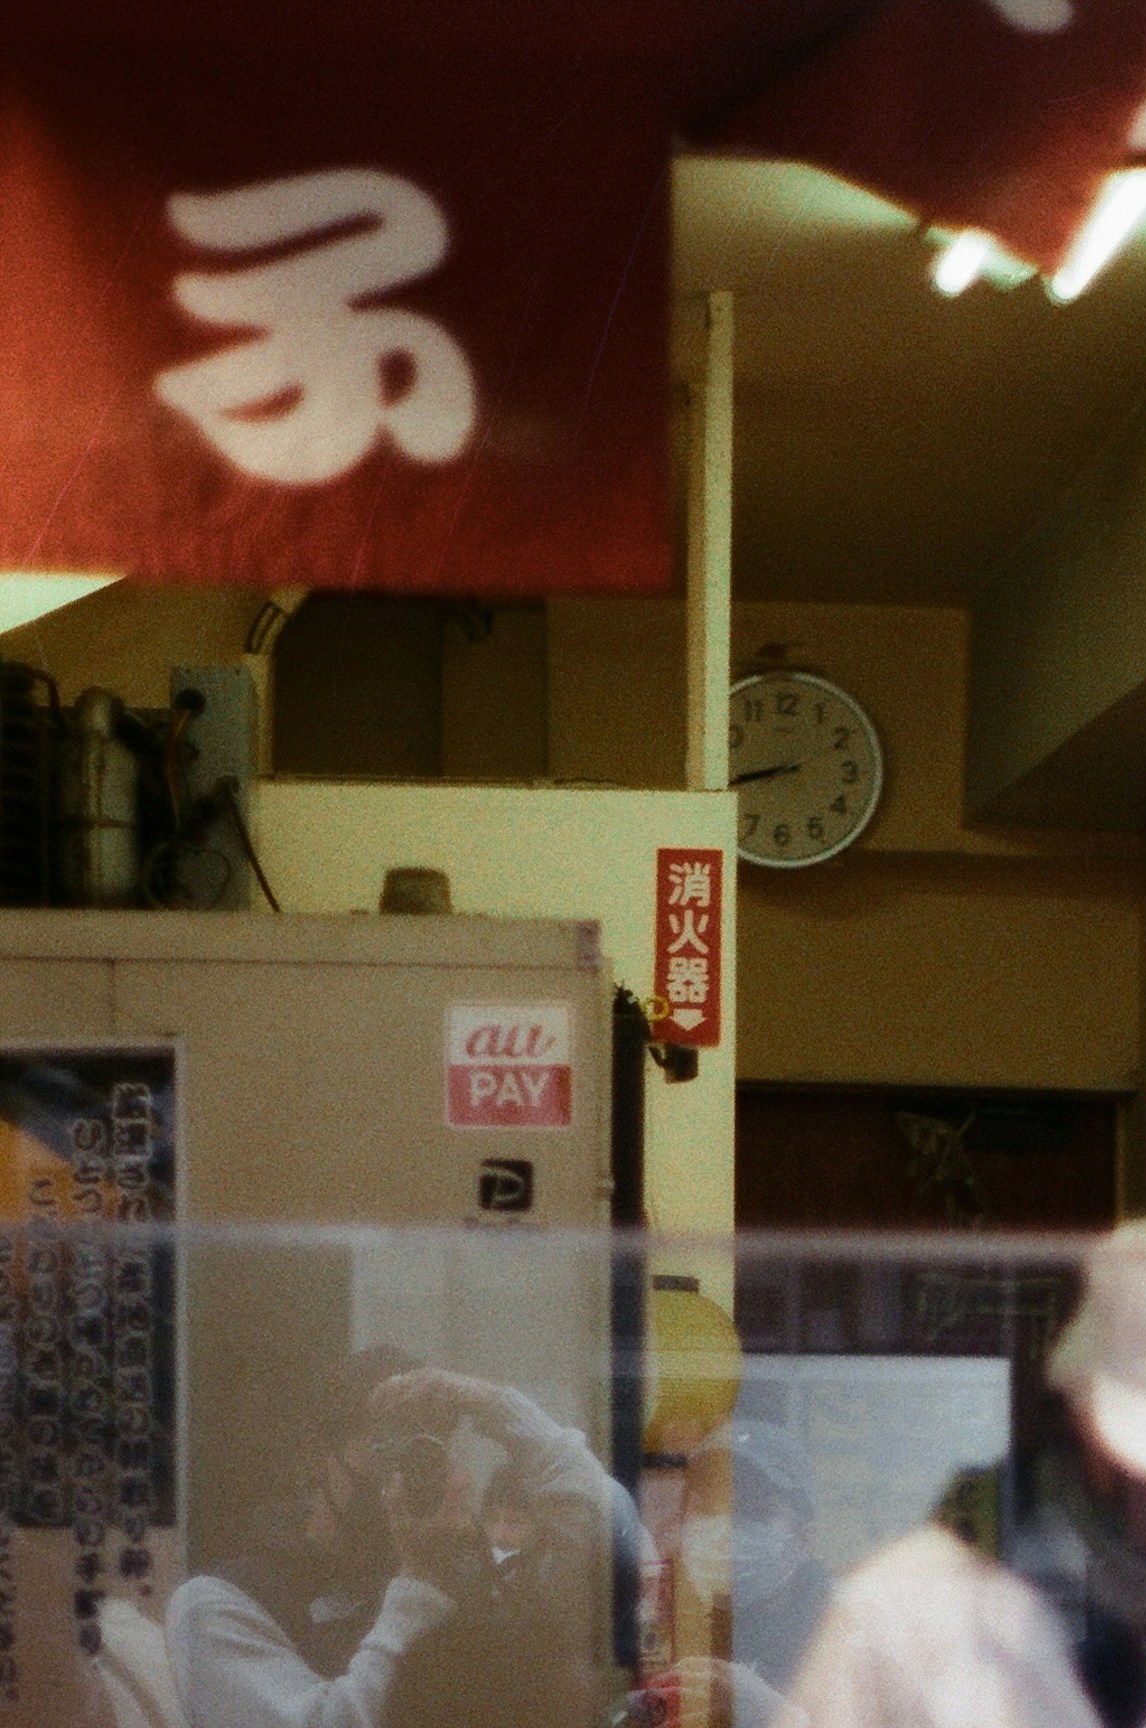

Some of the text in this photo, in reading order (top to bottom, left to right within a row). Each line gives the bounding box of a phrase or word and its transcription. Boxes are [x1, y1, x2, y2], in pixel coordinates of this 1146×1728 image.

[666, 861, 712, 1004] 消火器
[465, 1022, 556, 1058] au
[468, 1070, 550, 1108] PAY
